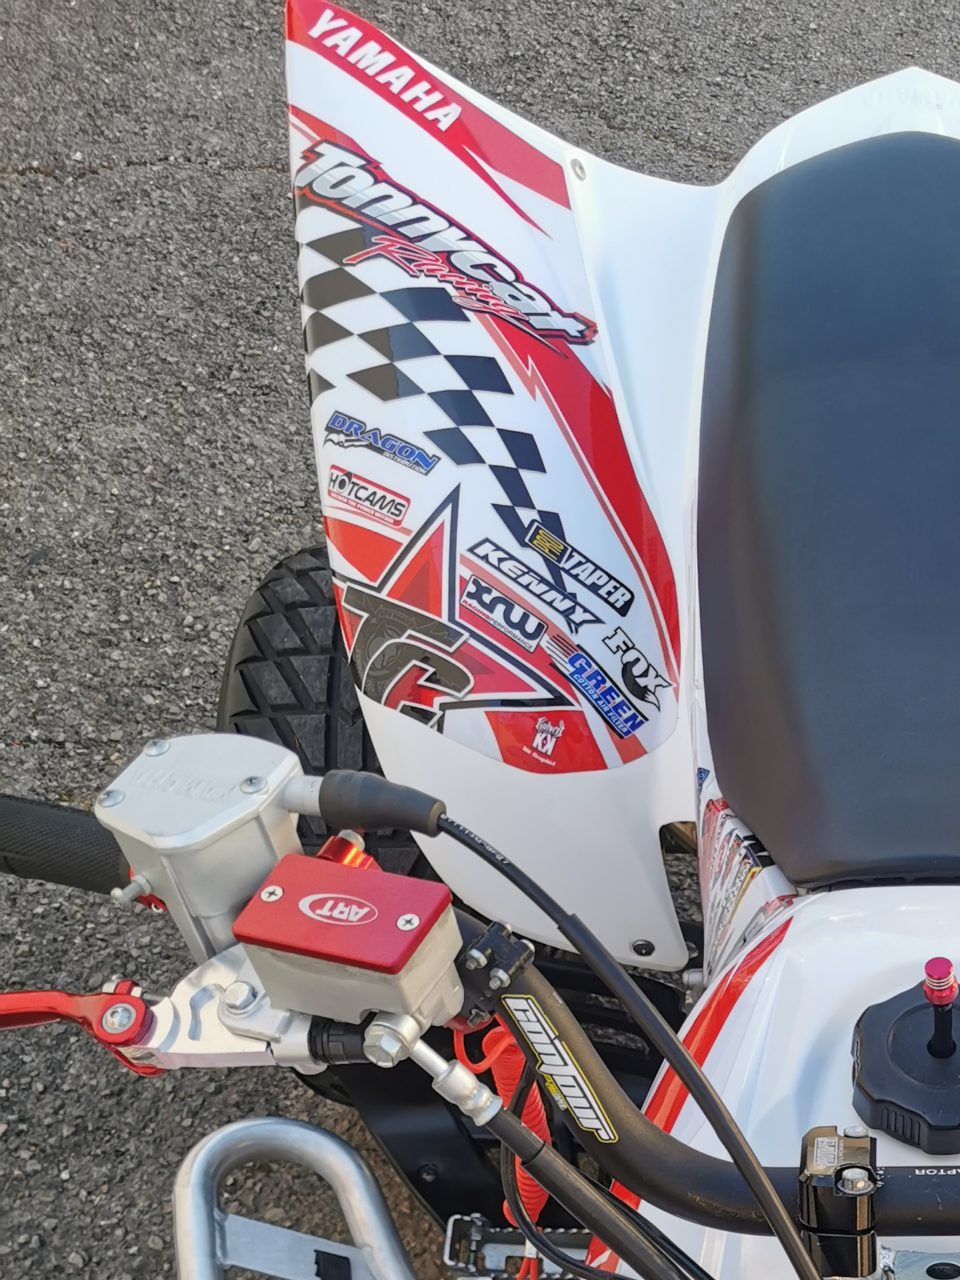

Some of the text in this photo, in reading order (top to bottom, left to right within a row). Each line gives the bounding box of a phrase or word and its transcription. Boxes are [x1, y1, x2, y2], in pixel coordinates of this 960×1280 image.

[307, 9, 464, 132] YAMAHA
[327, 412, 440, 473] DRAGON
[468, 541, 597, 627] KENNY
[560, 551, 629, 610] TAPER
[568, 652, 648, 735] GREEN
[603, 627, 673, 703] FOX
[606, 711, 629, 735] FILTER
[315, 896, 370, 923] ART
